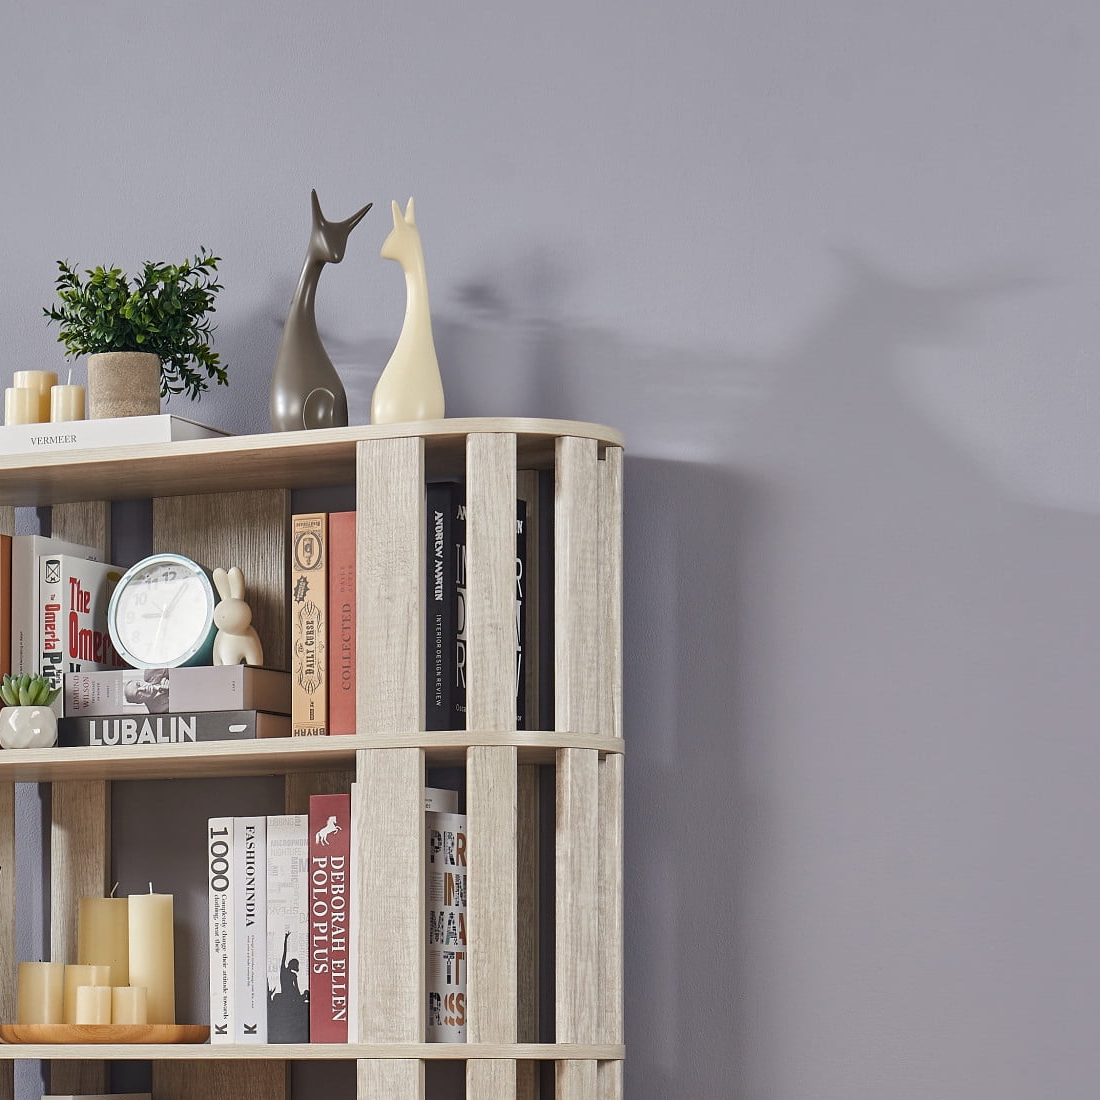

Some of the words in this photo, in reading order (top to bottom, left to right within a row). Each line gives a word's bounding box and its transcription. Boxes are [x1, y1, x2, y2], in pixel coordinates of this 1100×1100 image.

[30, 434, 77, 446] VERMEER
[434, 510, 444, 558] ANDREW
[68, 577, 91, 614] The
[434, 559, 444, 601] MARTIN
[44, 604, 61, 650] Omerta
[68, 611, 129, 668] Omer
[304, 620, 315, 645] CURSE
[342, 603, 351, 691] COLLECTED
[304, 649, 315, 675] DAILY
[72, 675, 80, 710] EDMUND
[89, 716, 197, 746] LUBALIN
[210, 827, 230, 892] 1000
[270, 838, 308, 847] MICROPHON
[245, 825, 256, 927] FASHIONINDIA
[312, 855, 328, 917] POLO
[220, 894, 228, 928] Completely
[330, 855, 346, 952] DEBORAH
[312, 920, 329, 974] PLUS
[331, 958, 347, 1022] ELLEN
[214, 1023, 228, 1035] K
[243, 1023, 257, 1035] K
